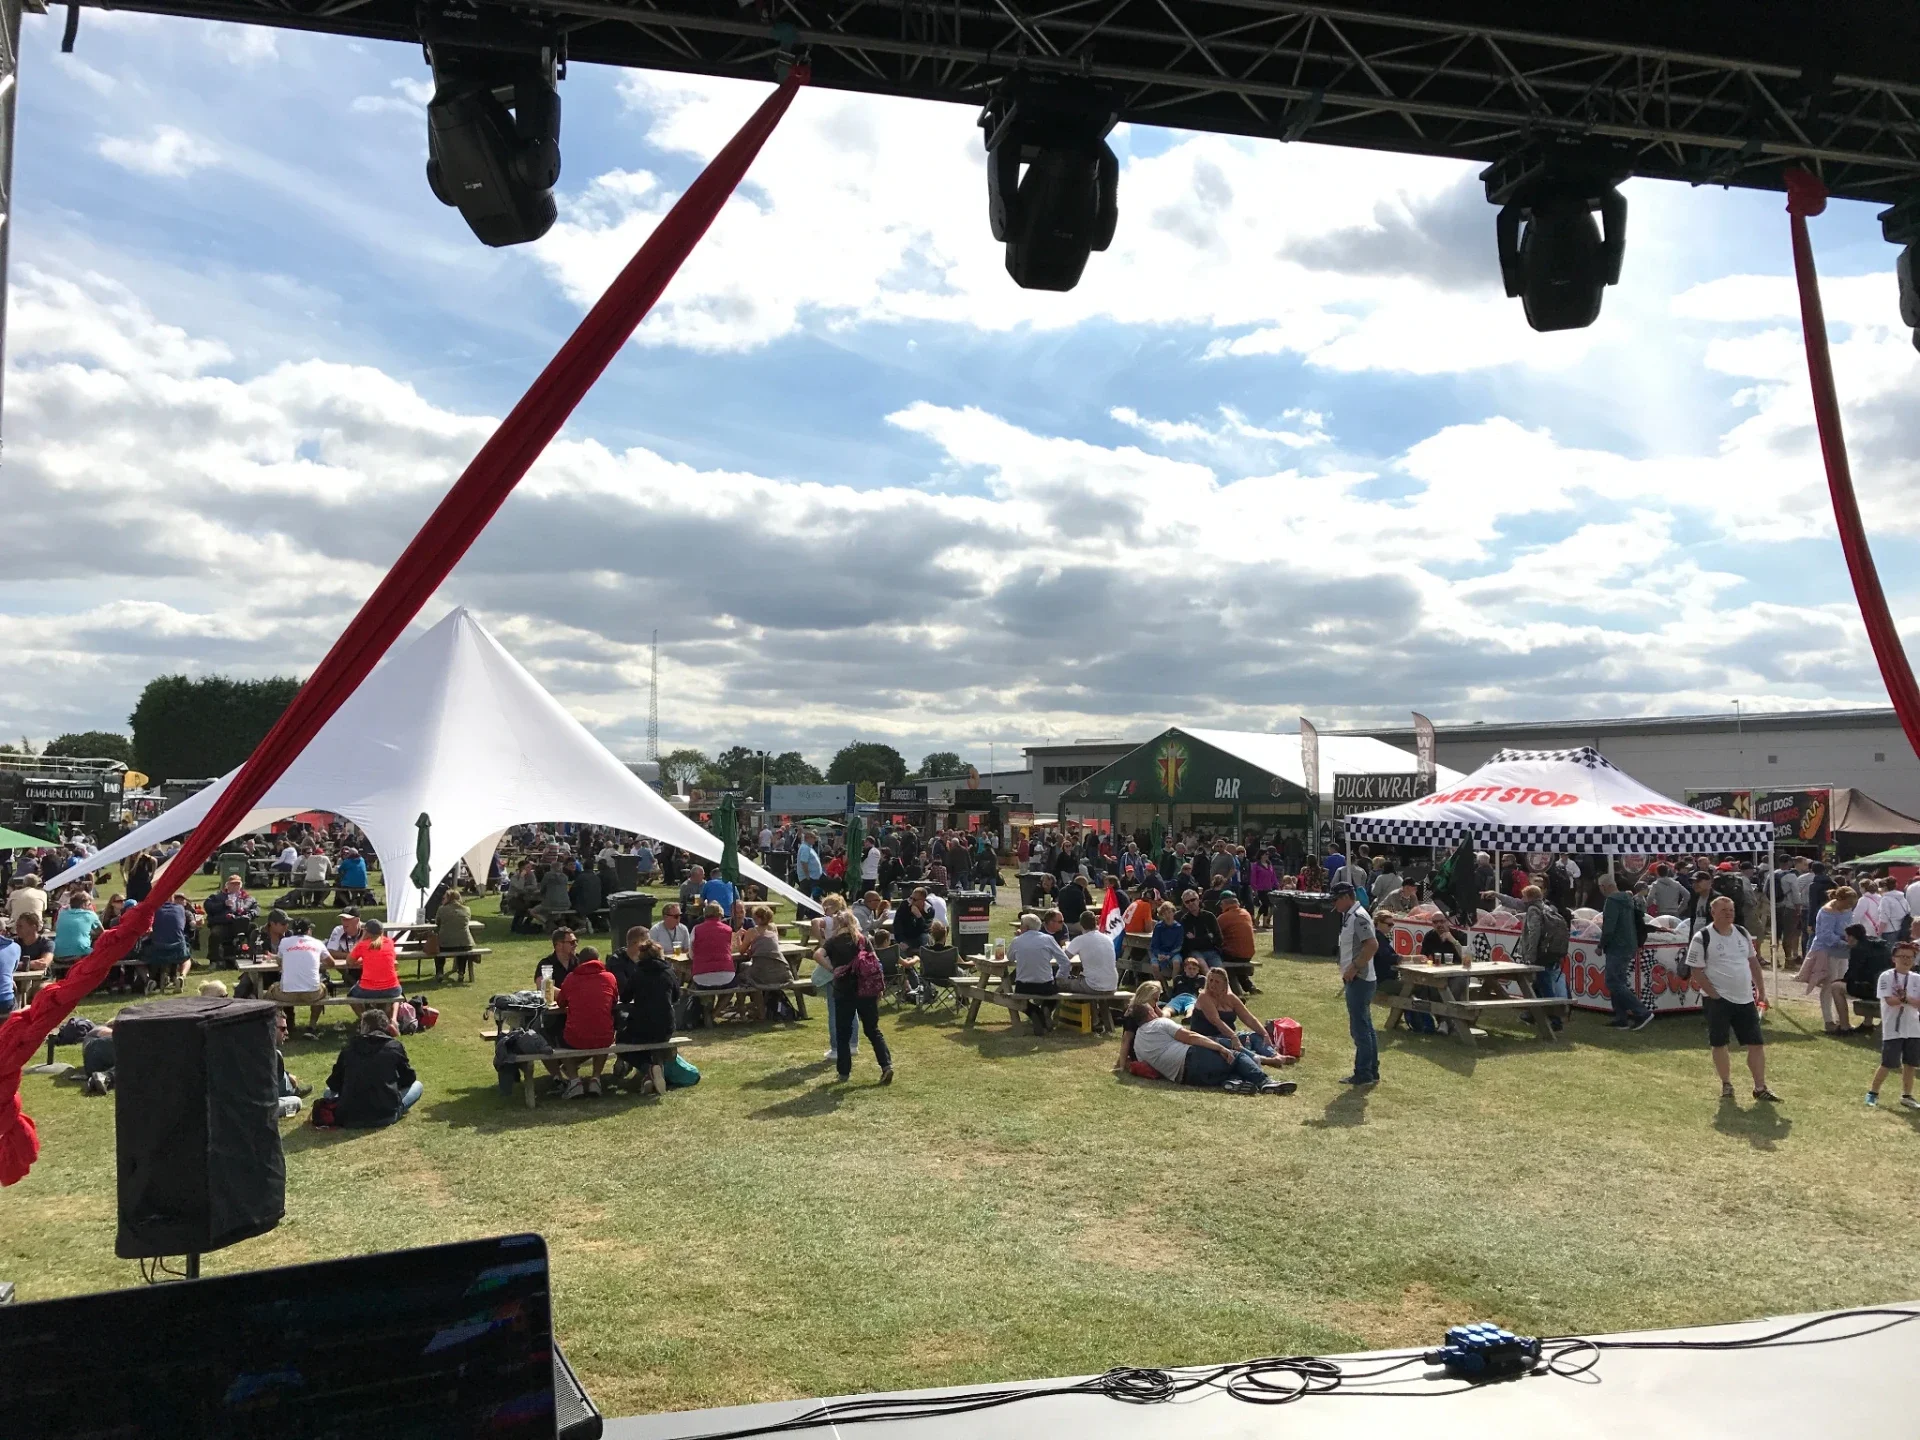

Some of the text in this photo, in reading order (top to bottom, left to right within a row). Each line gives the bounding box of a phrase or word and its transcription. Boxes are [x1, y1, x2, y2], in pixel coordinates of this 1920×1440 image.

[25, 787, 64, 798] CHAMPAGNE
[70, 789, 95, 799] OYSTERS
[103, 782, 121, 794] BAR
[1215, 778, 1241, 799] BAR
[1337, 777, 1374, 798] DUCK
[1418, 786, 1579, 807] SWEET STOP
[1704, 796, 1722, 810] DOGS
[1336, 804, 1360, 816] DUCK
[1758, 796, 1794, 815] HOT DOGS
